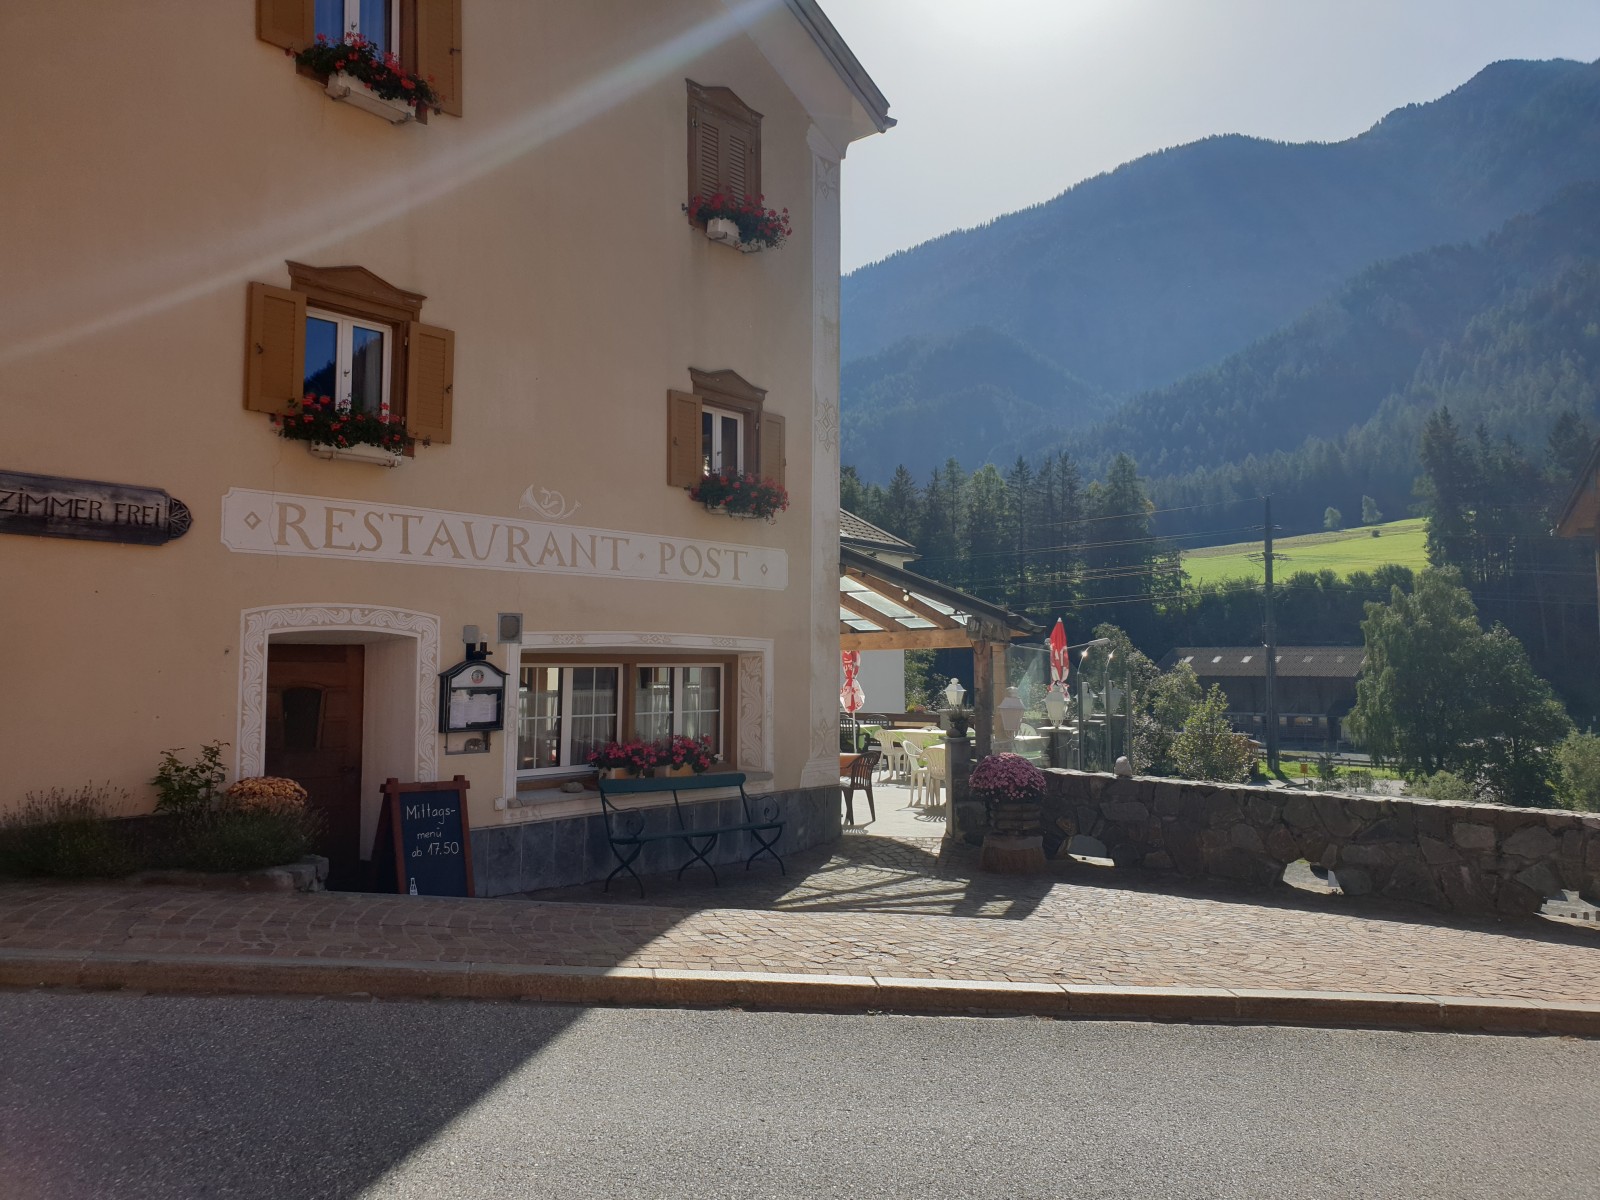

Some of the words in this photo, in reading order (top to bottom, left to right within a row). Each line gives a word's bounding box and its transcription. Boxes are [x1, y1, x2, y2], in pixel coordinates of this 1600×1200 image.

[273, 501, 630, 571] RESTAURANT
[658, 541, 748, 581] POST
[406, 803, 456, 825] Mittags-
[411, 846, 423, 858] ab
[427, 841, 460, 856] 17.50
